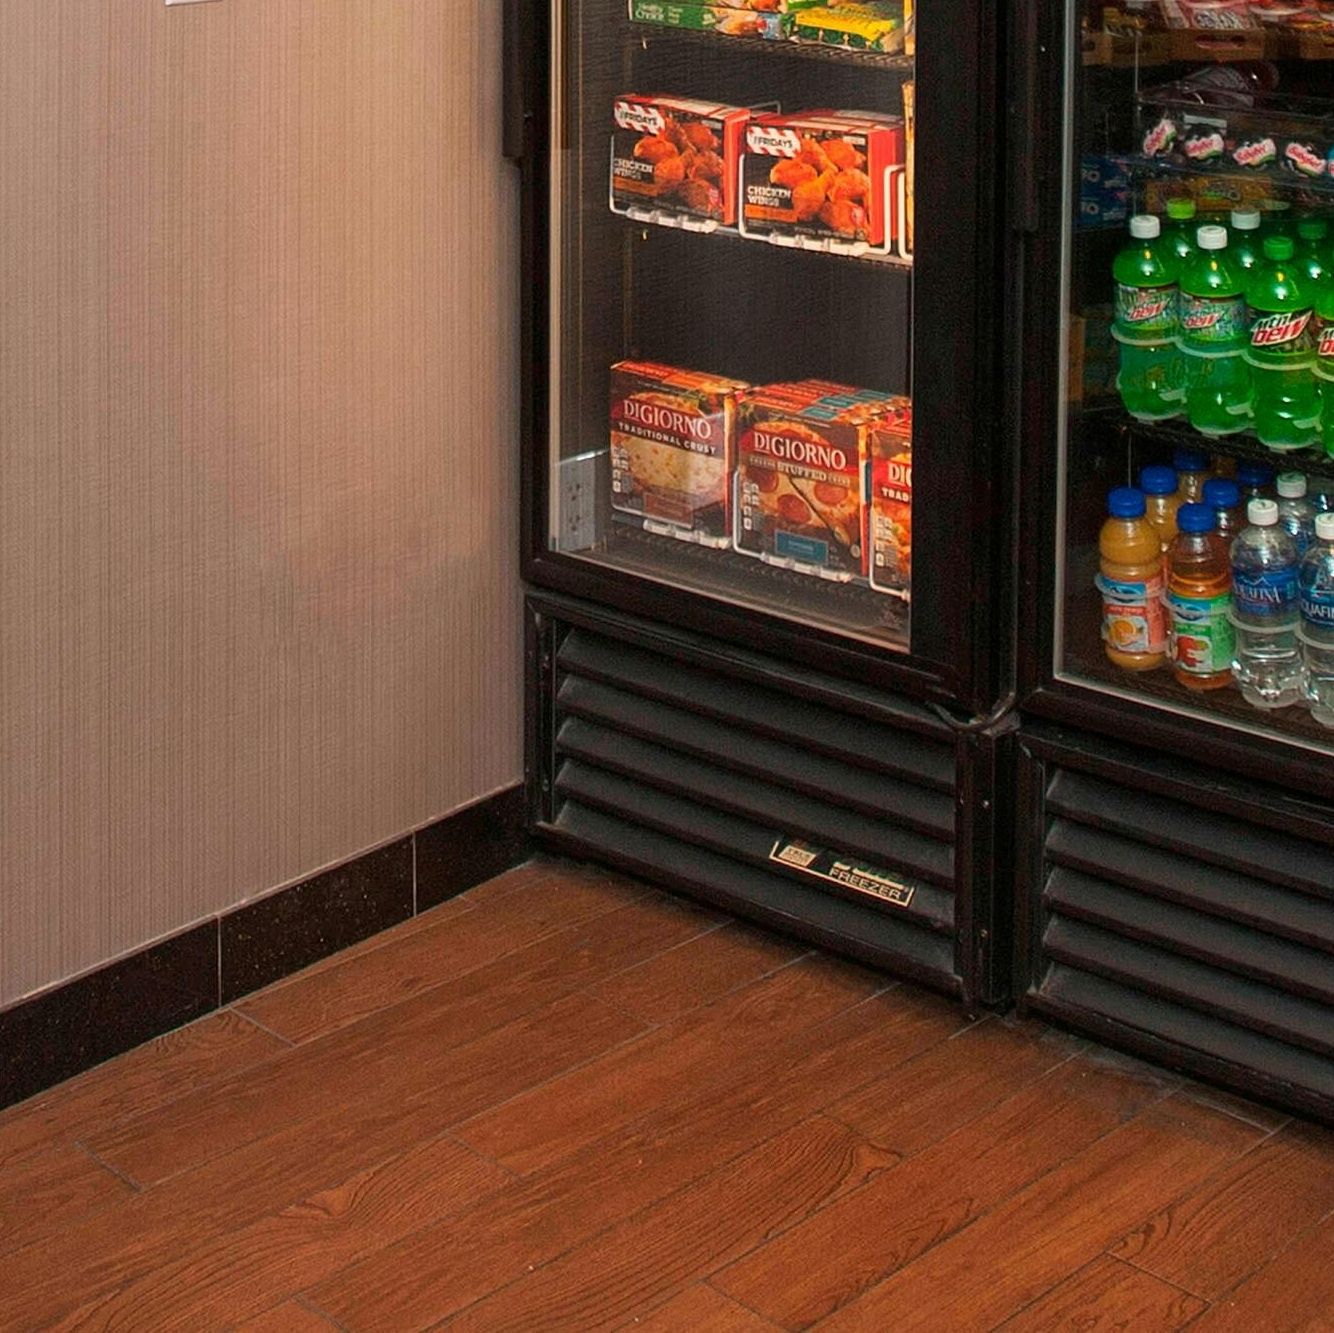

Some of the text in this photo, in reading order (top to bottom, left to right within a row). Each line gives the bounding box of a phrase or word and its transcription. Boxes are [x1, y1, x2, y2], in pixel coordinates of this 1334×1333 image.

[623, 109, 658, 127] FRIDAYS
[757, 133, 794, 149] FRIDAYS
[747, 185, 792, 200] CHICKEN
[623, 399, 712, 440] DIGIORNO
[619, 422, 716, 455] TRADITIONAL CRUST
[753, 431, 847, 470] DIGIORNO
[777, 461, 827, 481] STUFFED
[1234, 585, 1281, 604] QUAFINA
[828, 868, 902, 900] FREEZER
